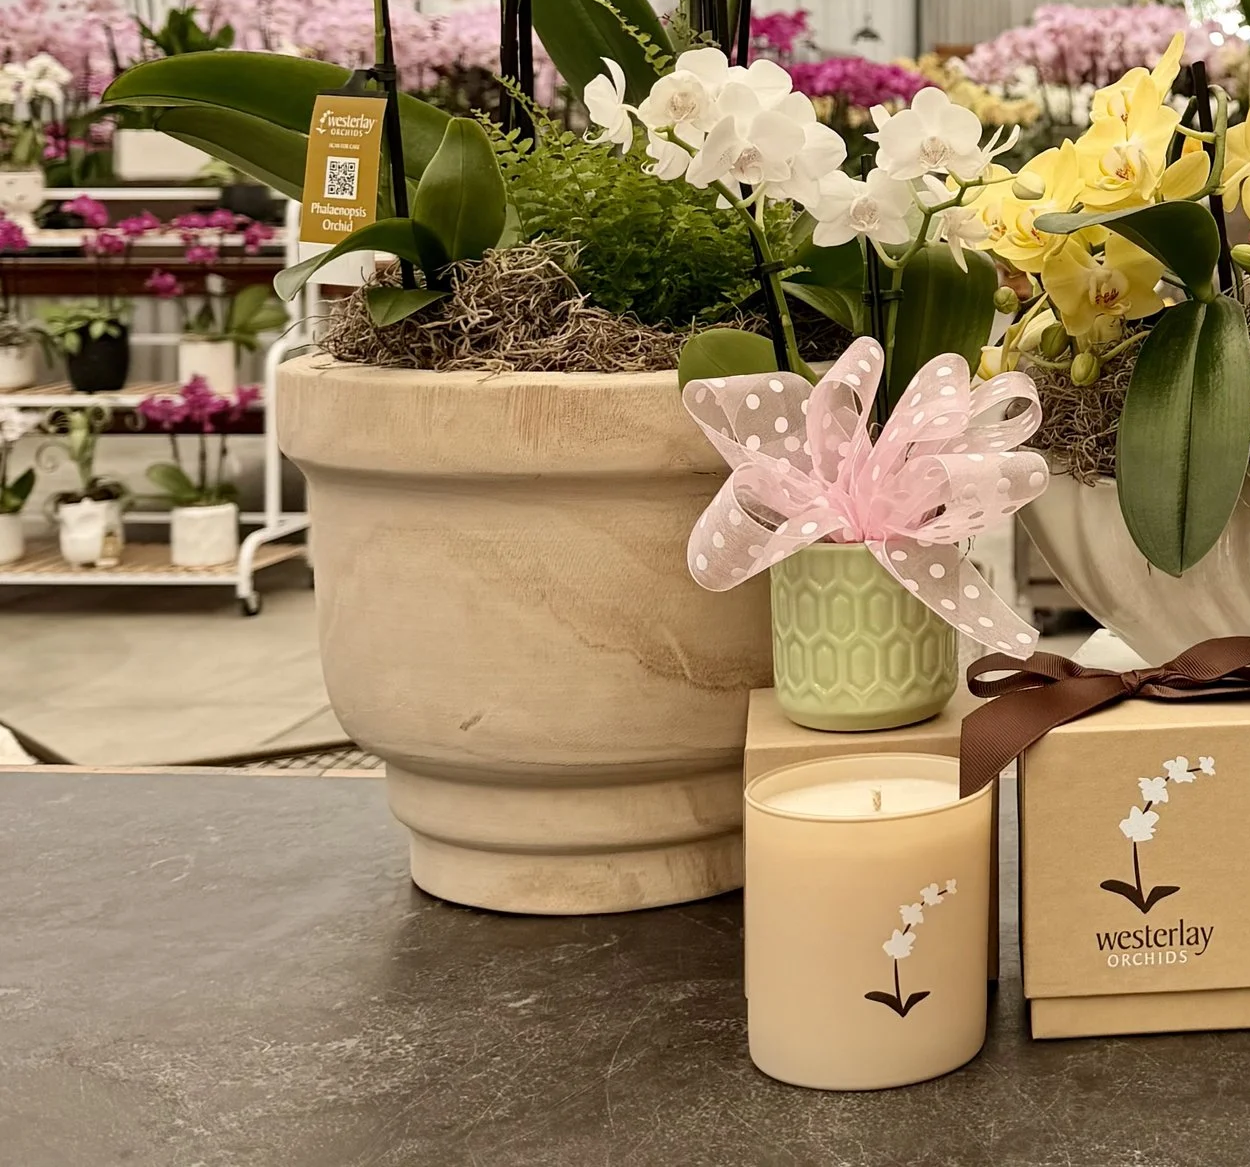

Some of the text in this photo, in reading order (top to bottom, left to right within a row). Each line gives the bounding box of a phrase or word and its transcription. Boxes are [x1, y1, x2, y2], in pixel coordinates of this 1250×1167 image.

[328, 114, 375, 134] westerlay
[330, 128, 363, 137] ORCHIDS
[311, 203, 366, 220] Phalaenopsis
[322, 219, 352, 232] Orchid
[1096, 918, 1214, 956] westerlay
[1107, 950, 1188, 968] ORCHIDS
